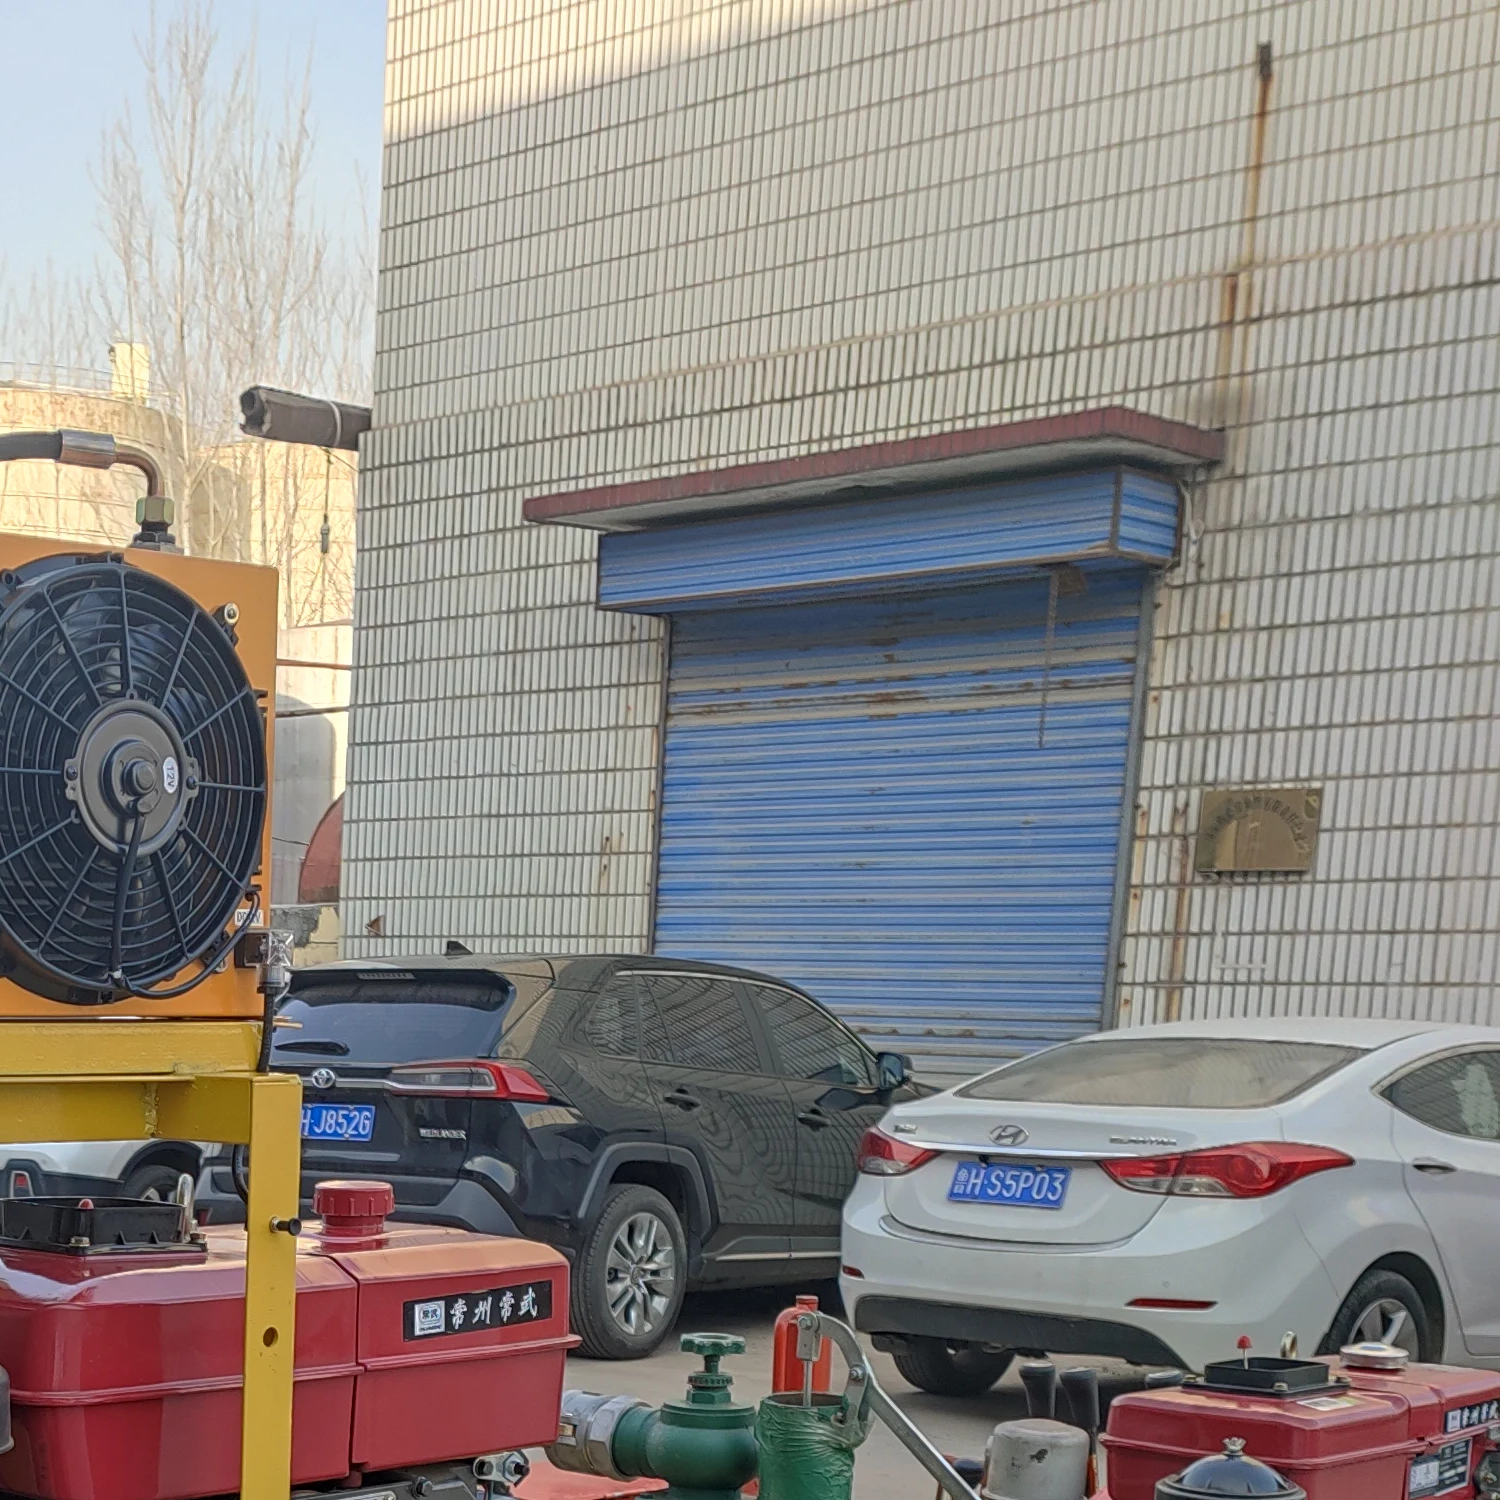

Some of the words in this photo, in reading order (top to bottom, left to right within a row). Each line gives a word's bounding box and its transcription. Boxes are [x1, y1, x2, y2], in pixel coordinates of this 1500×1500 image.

[166, 765, 175, 788] 12V
[449, 1286, 539, 1330] 常州常武
